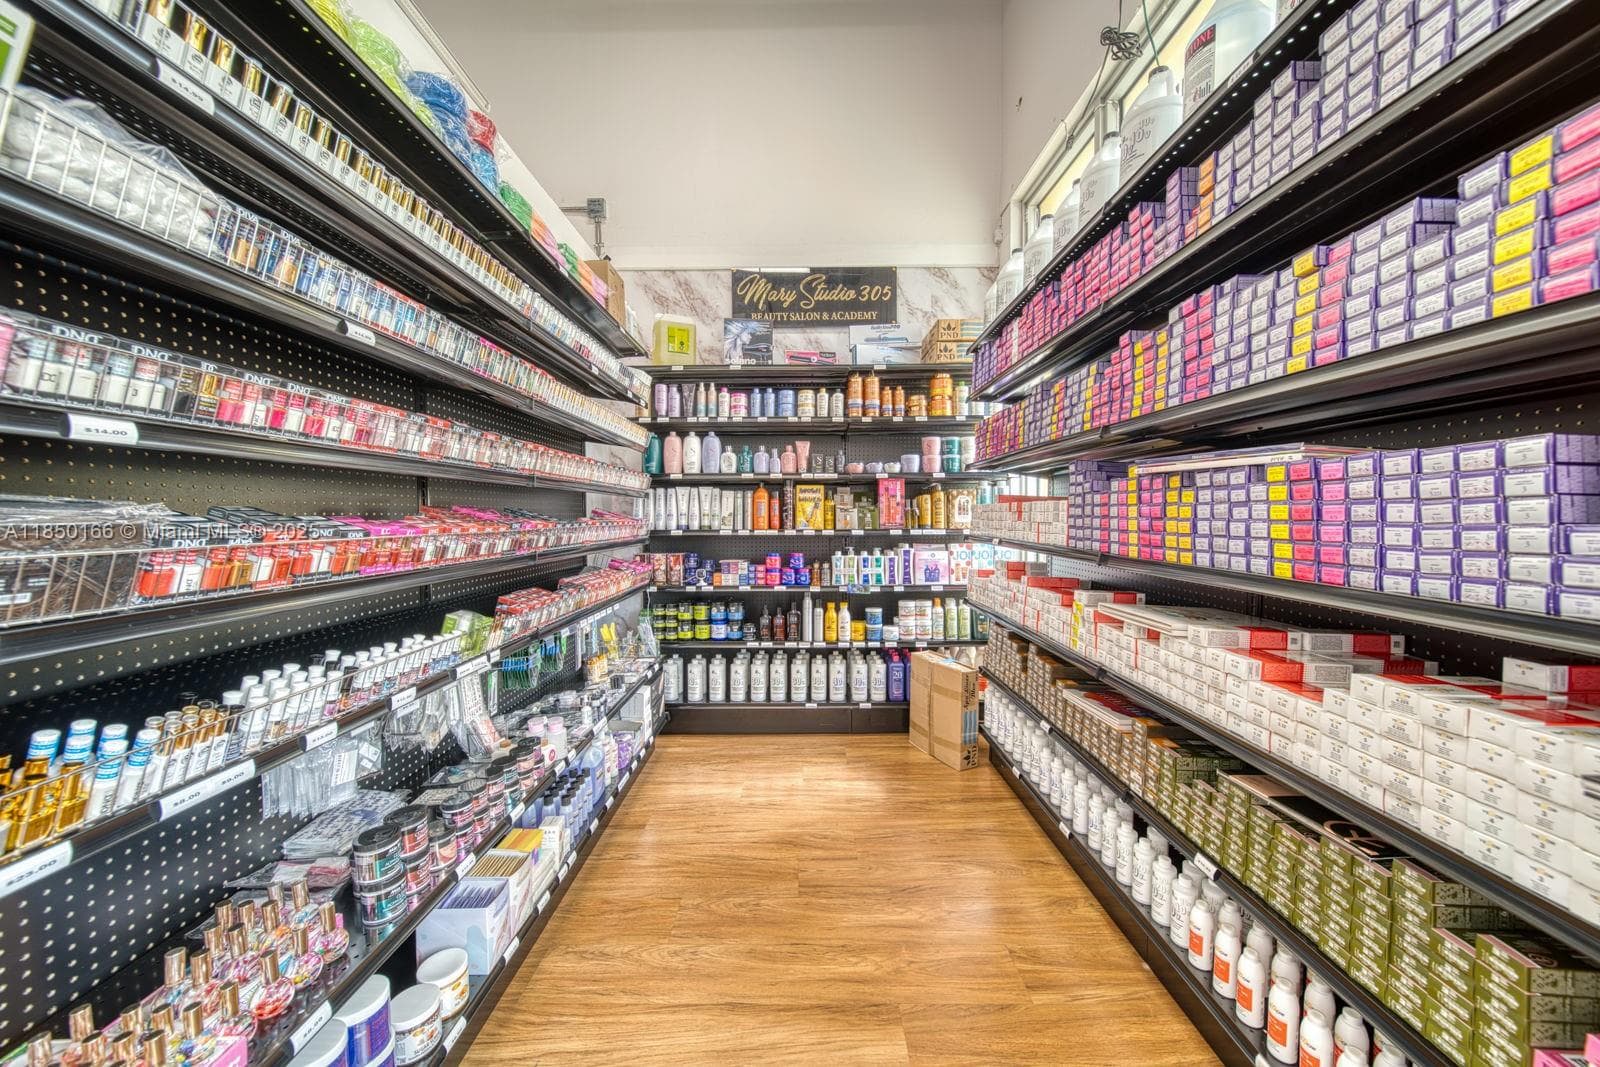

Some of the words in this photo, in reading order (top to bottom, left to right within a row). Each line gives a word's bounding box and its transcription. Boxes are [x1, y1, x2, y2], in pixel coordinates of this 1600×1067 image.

[737, 273, 797, 310] Mary
[800, 273, 857, 309] Studio
[858, 285, 892, 301] 305
[751, 311, 787, 321] BEAUTY
[789, 311, 820, 321] SALON
[822, 312, 829, 320] &
[831, 311, 878, 320] ACADEMY
[84, 427, 128, 436] $14.00
